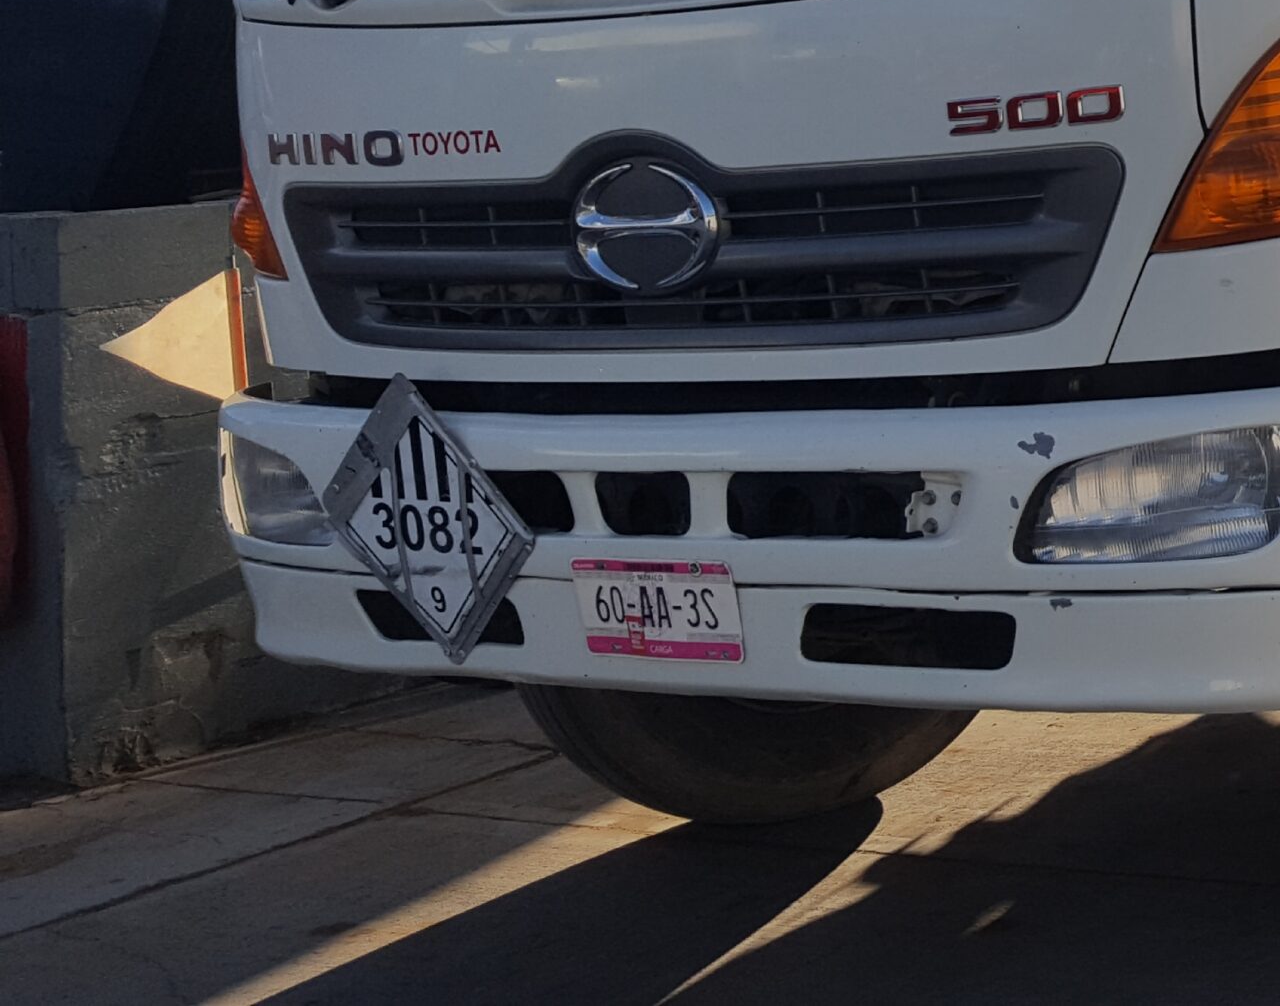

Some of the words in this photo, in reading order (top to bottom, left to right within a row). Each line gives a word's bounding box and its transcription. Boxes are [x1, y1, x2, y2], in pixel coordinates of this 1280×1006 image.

[946, 84, 1125, 136] 500
[267, 129, 405, 167] HINO
[408, 129, 501, 156] TOYOTA
[372, 502, 484, 555] 3082
[431, 586, 446, 613] 9
[595, 585, 719, 630] 60-AA-3S
